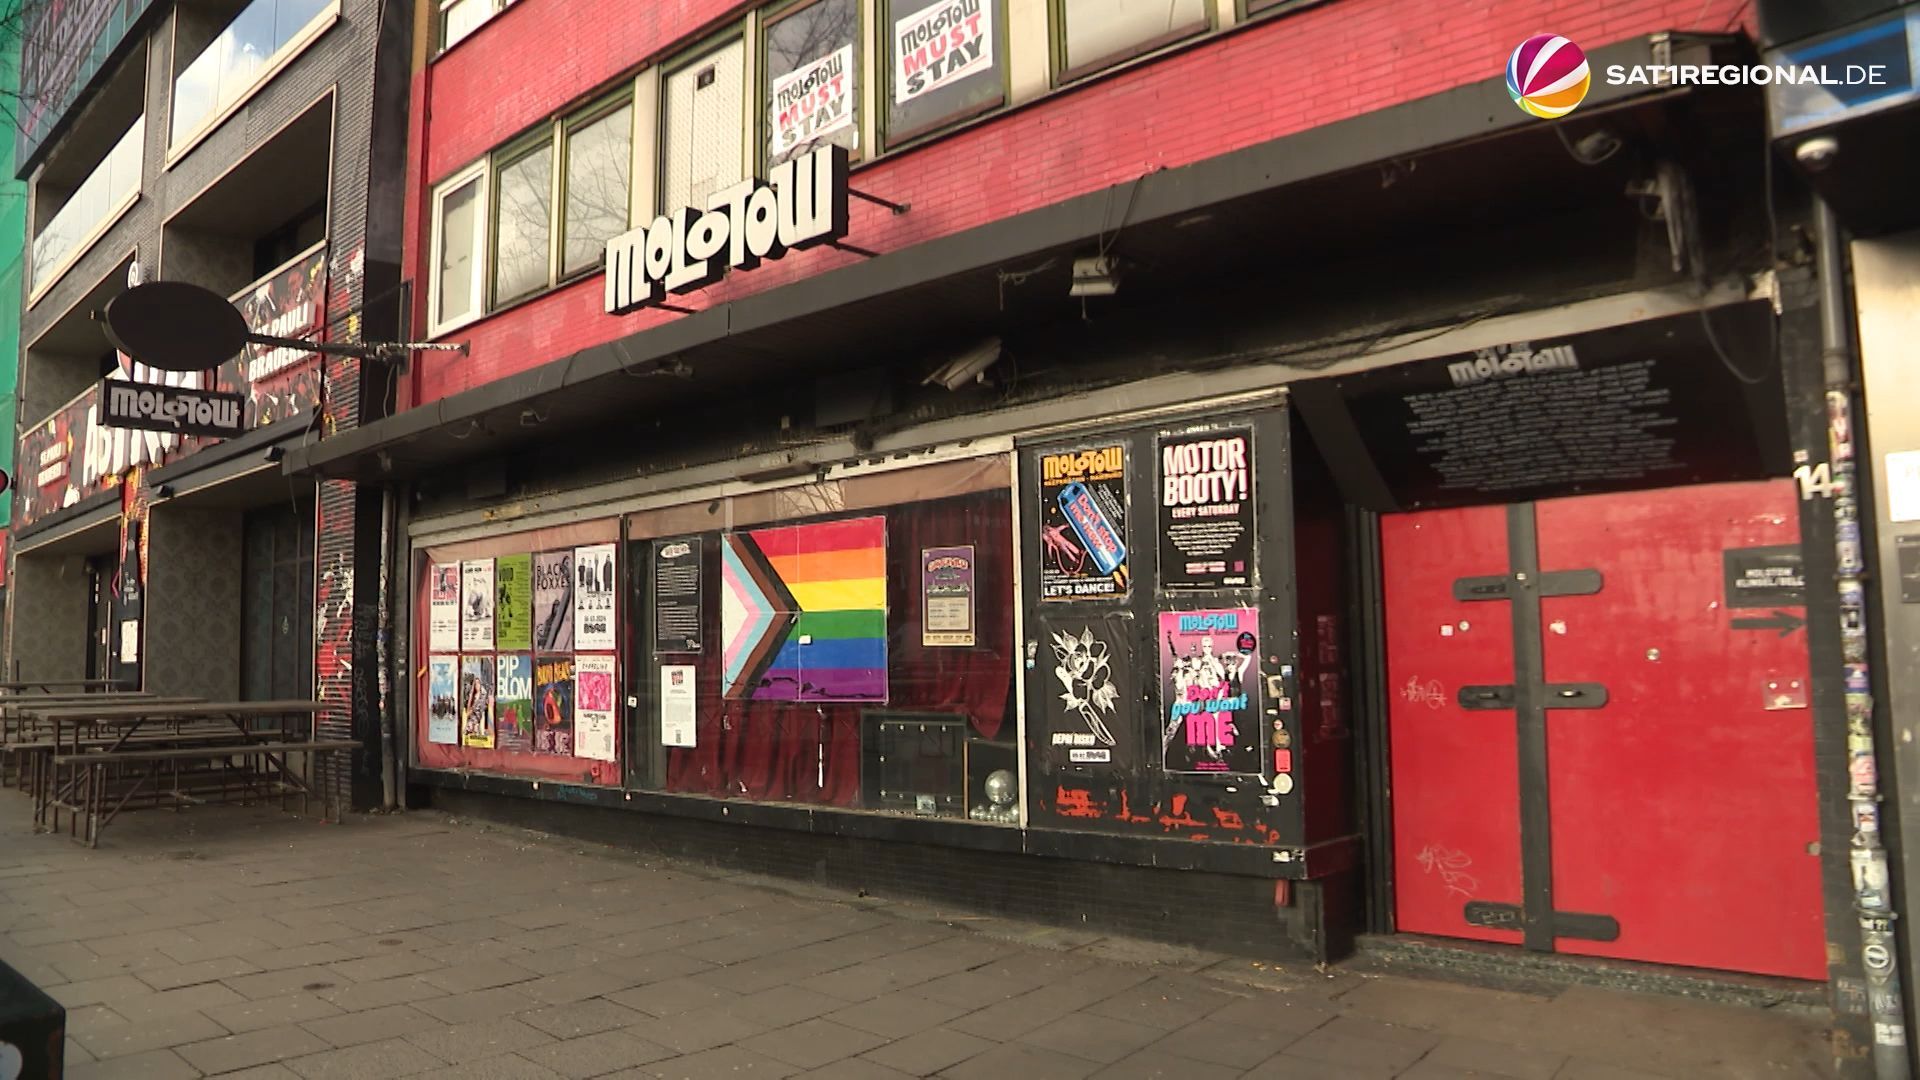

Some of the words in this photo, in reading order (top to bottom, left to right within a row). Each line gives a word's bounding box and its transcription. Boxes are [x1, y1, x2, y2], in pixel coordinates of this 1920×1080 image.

[901, 0, 980, 55] MOLOTOW
[903, 13, 981, 76] MUST
[777, 53, 843, 111] MOLOTOW
[906, 33, 984, 95] STAY
[779, 74, 844, 131] MUST
[781, 92, 845, 148] STAY
[605, 144, 834, 313] MOLOTOW
[110, 386, 240, 428] MOLOTOW
[1043, 447, 1123, 480] MOLOTOW
[1163, 437, 1247, 476] MOTOR
[1163, 468, 1248, 507] BOOTY!
[1793, 463, 1837, 500] 14
[1172, 506, 1197, 518] EVERY
[1198, 503, 1240, 517] SATURDAY
[1044, 584, 1074, 597] LET'S
[1075, 582, 1116, 595] DANCE!
[1179, 613, 1239, 632] MOLOTOW
[497, 655, 519, 678] PIP
[497, 677, 532, 700] BLOM
[1171, 700, 1202, 721] you
[1205, 693, 1249, 714] want
[1186, 681, 1231, 702] Don't
